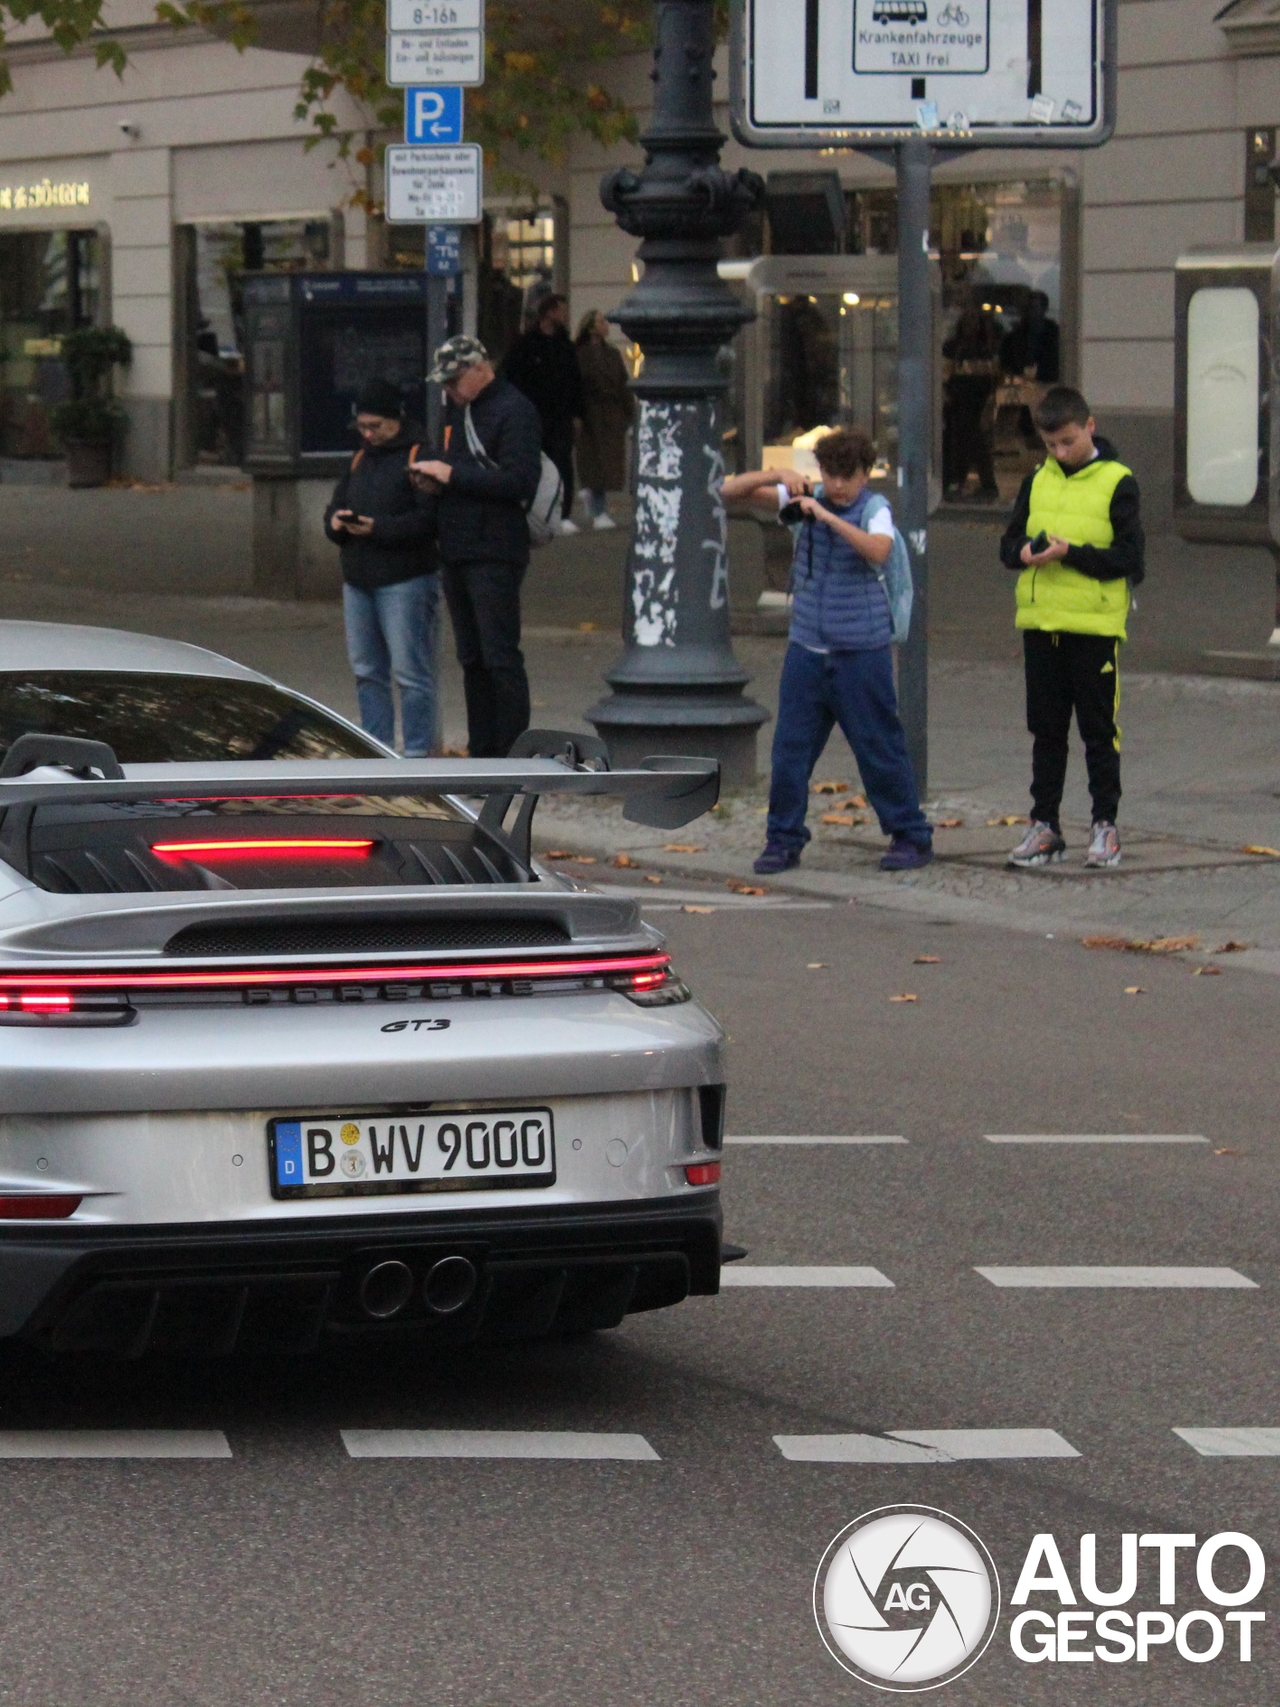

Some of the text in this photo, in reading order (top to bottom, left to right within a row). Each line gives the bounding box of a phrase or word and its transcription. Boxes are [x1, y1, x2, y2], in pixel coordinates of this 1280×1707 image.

[859, 30, 982, 47] Krankenfahrzeuge
[891, 51, 950, 65] TAXI frei
[415, 92, 445, 137] P
[245, 979, 534, 1003] PORSCHE
[380, 1018, 451, 1033] GT3
[307, 1128, 335, 1177] B
[369, 1124, 425, 1174] WV
[437, 1119, 545, 1171] 9000
[285, 1160, 295, 1175] D
